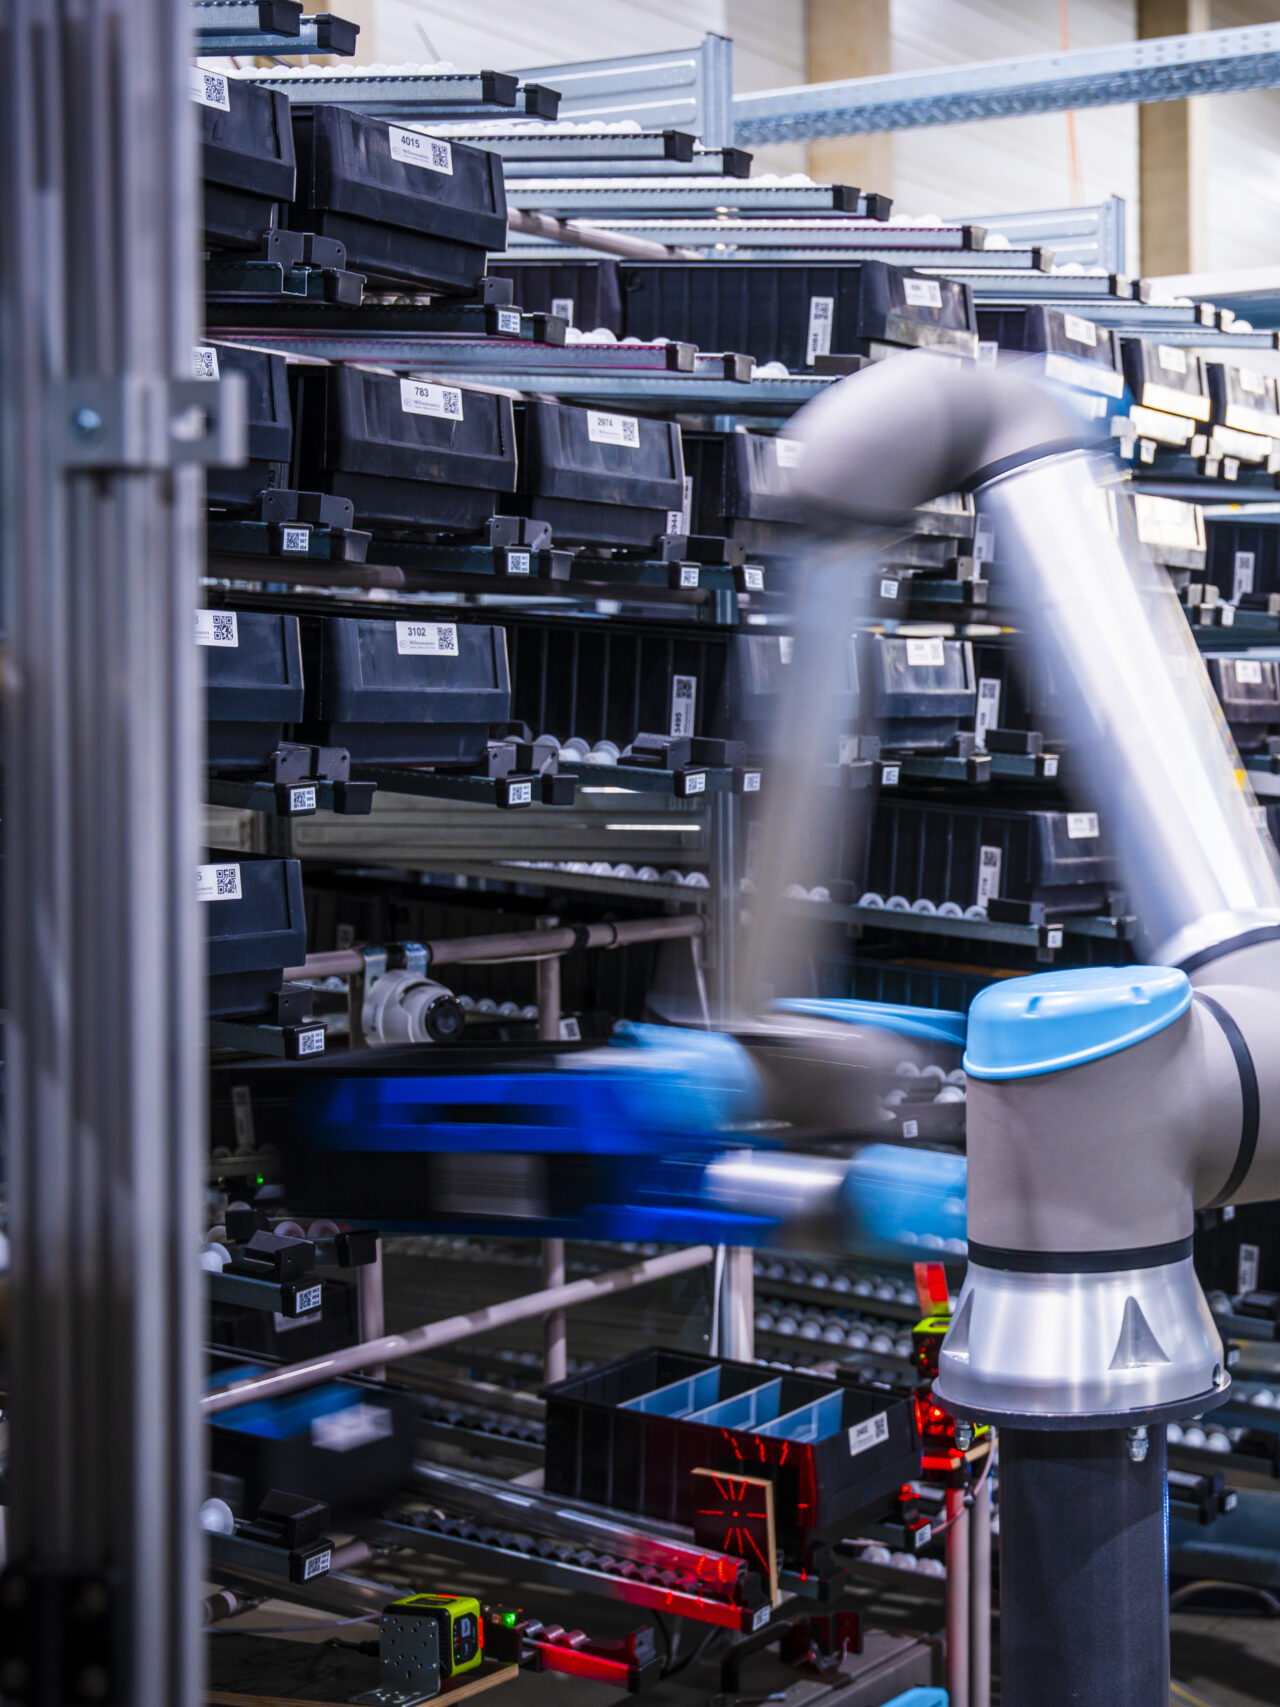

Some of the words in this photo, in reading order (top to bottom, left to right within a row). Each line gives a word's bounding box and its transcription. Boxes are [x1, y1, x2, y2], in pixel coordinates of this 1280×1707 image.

[401, 135, 420, 149] 4015
[414, 386, 429, 398] 783
[407, 626, 426, 637] 3102
